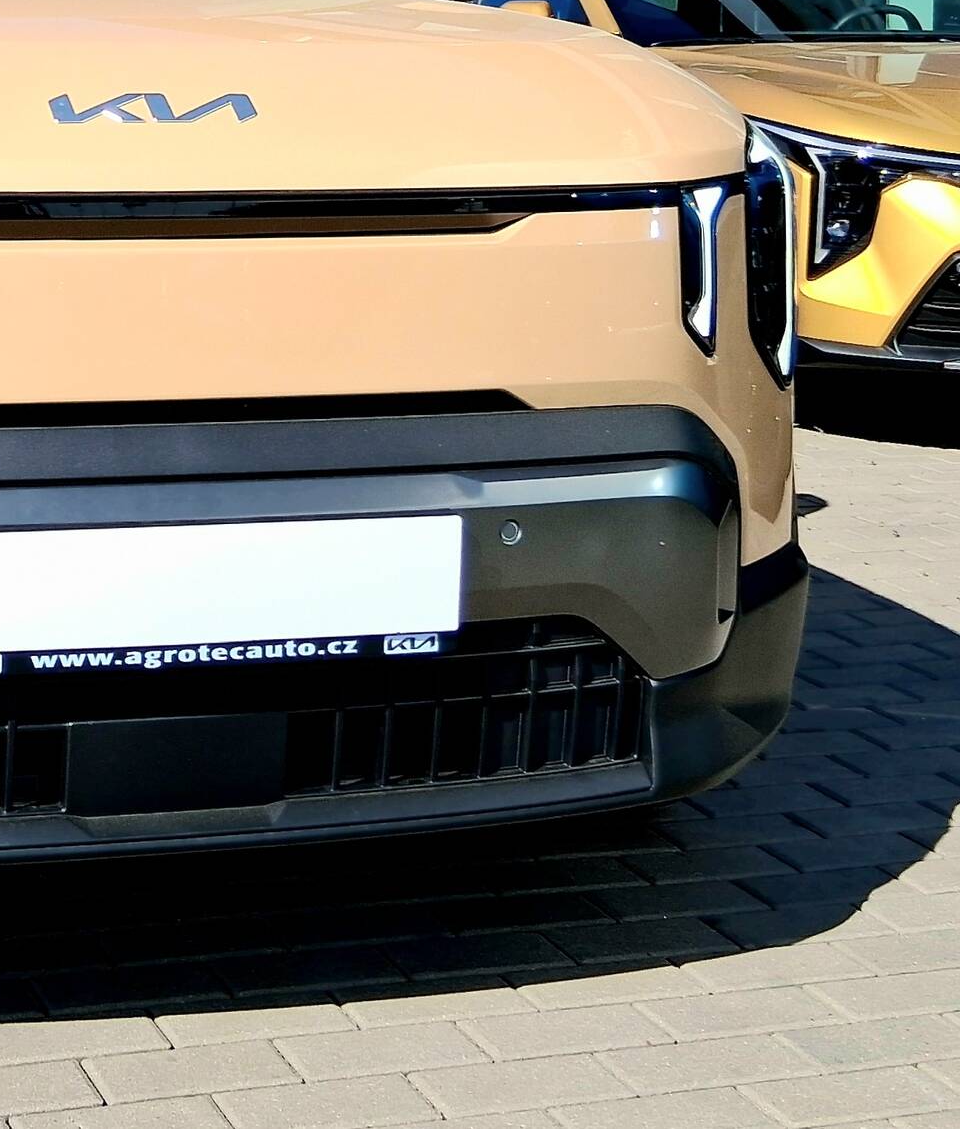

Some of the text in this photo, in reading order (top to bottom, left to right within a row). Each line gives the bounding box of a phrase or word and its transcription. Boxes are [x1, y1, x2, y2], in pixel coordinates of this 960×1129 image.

[48, 92, 258, 123] KIA
[31, 639, 359, 669] www.agrotecauto.cz
[386, 635, 436, 652] KIA
